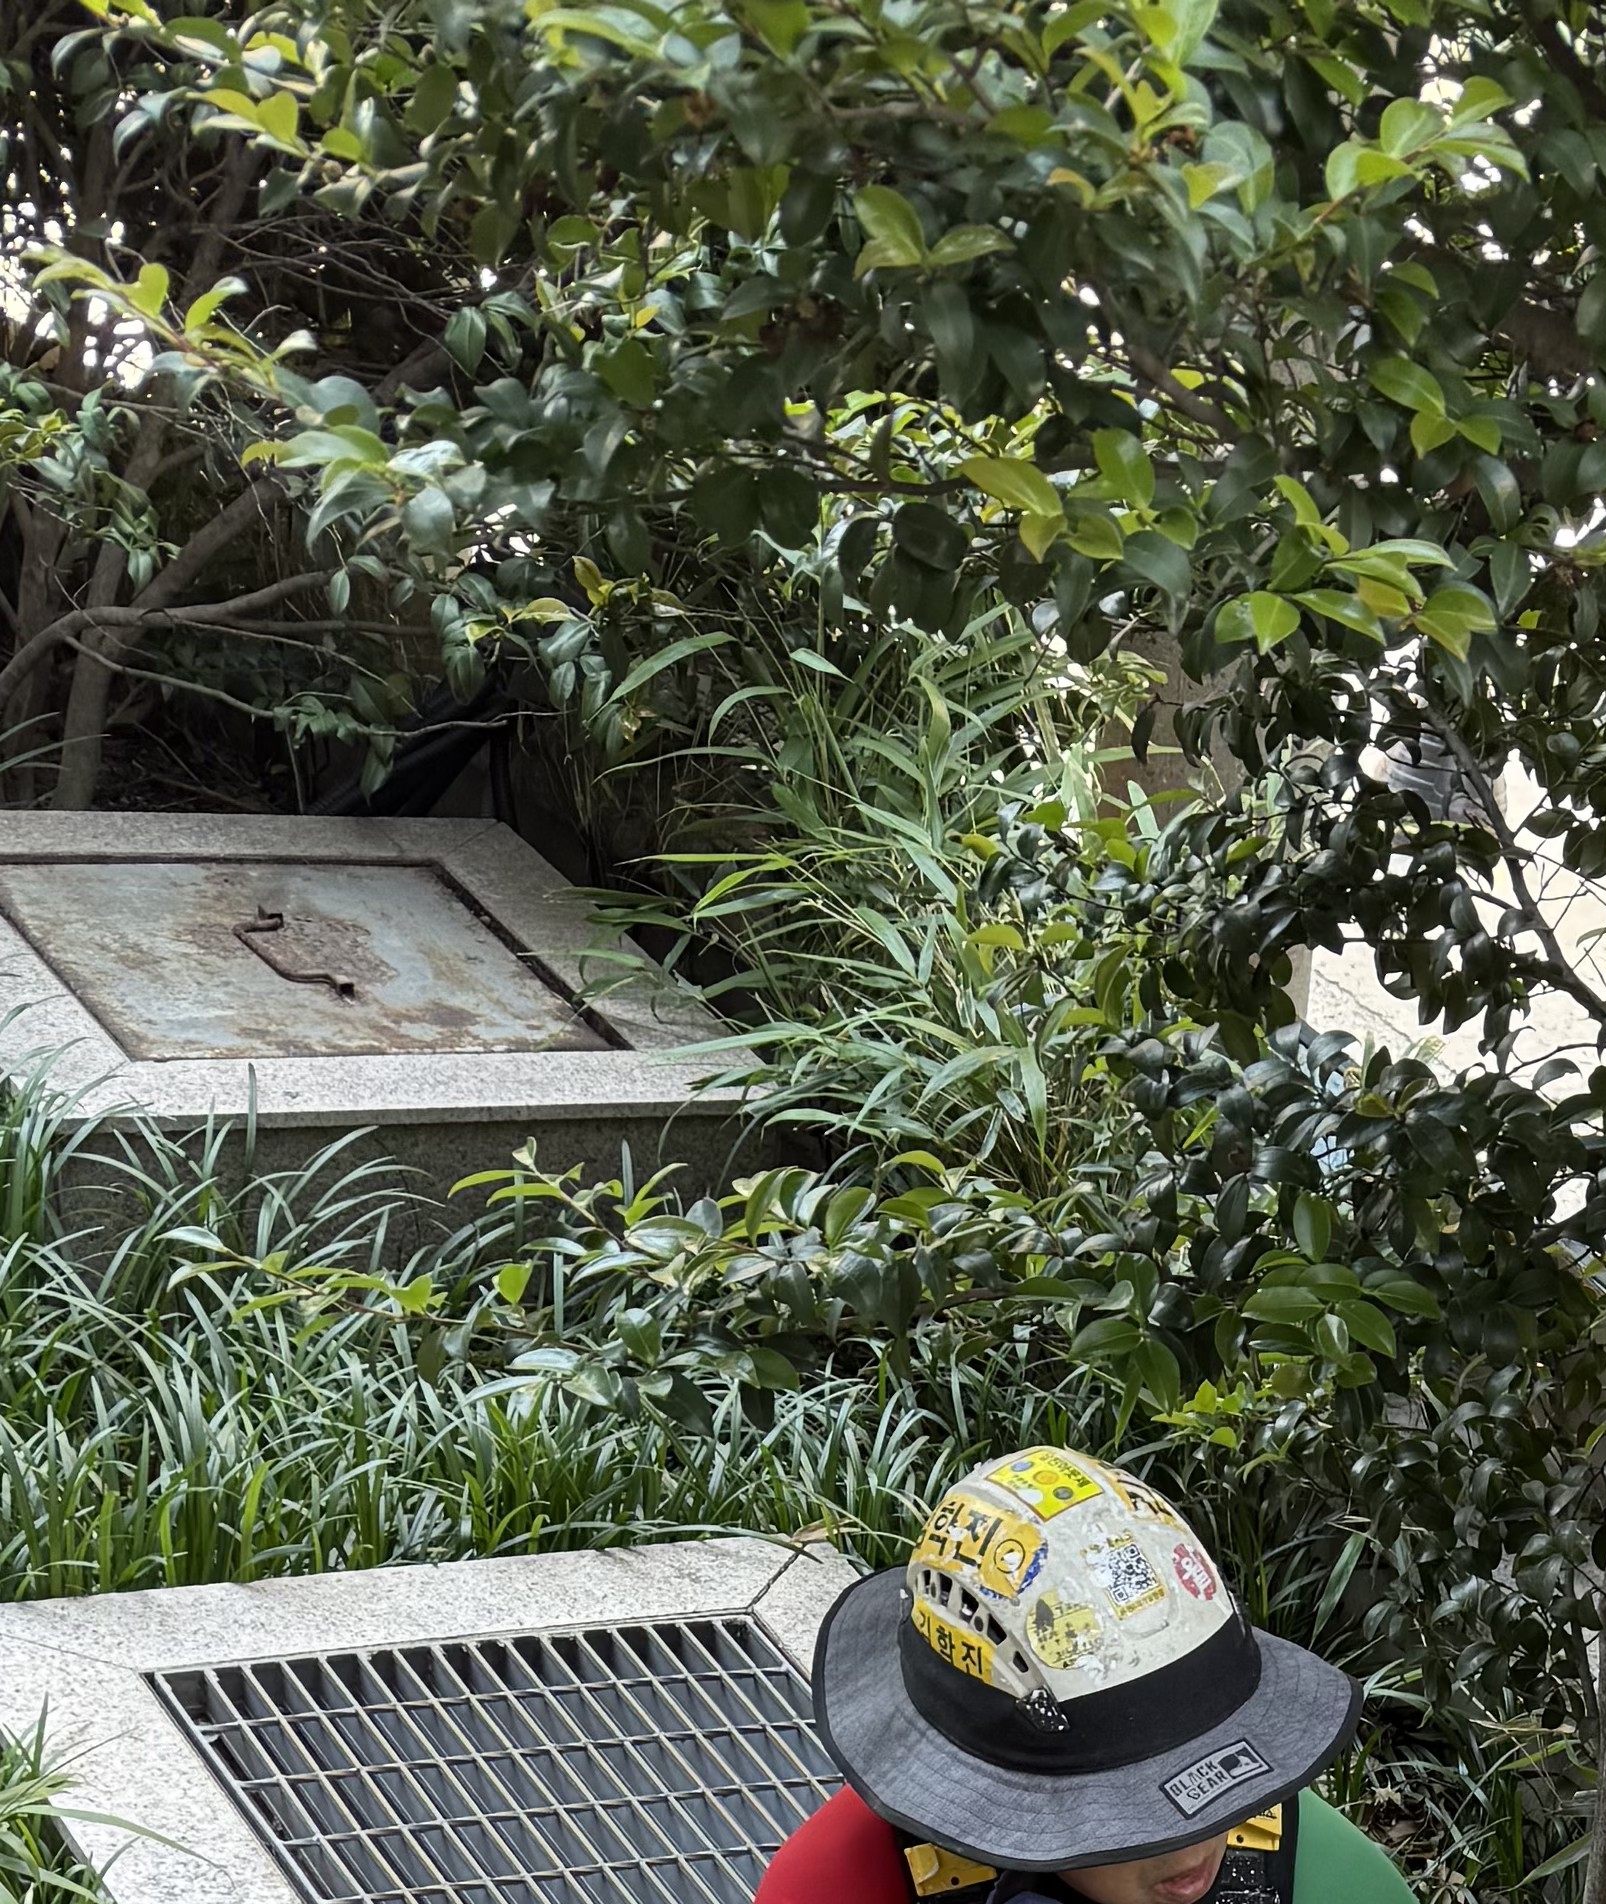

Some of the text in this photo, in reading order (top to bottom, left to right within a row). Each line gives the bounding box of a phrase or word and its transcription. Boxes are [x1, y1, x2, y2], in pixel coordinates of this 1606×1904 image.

[917, 1501, 1004, 1568] 학진
[1169, 1760, 1218, 1797] BLACK
[1186, 1770, 1229, 1800] GEAR
